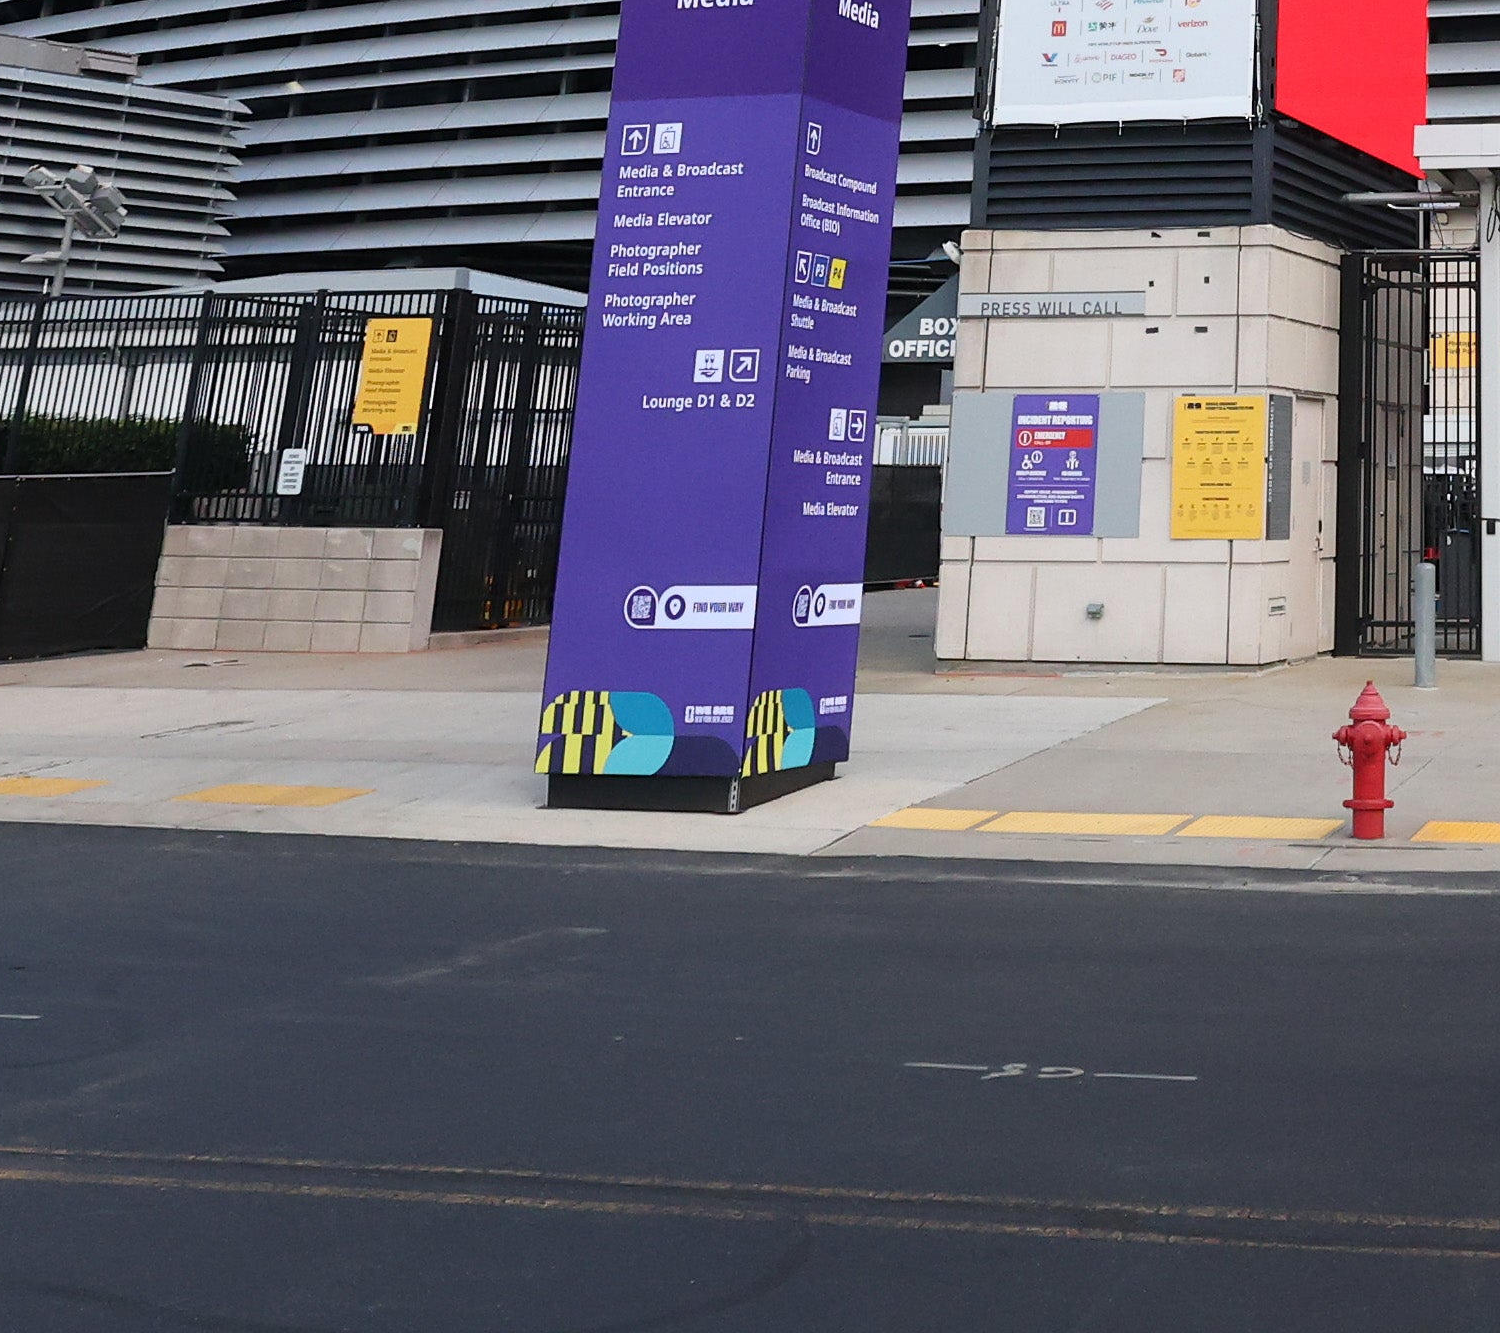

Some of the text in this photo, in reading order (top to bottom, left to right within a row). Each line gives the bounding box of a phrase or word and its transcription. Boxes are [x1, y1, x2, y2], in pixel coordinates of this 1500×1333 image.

[1177, 20, 1208, 28] verizon
[1111, 53, 1137, 61] DIAGEO
[1103, 73, 1117, 82] PIF
[619, 162, 744, 179] Media & Broadcast
[805, 164, 877, 195] Broadcast Compound
[617, 184, 674, 198] Entrance
[802, 194, 879, 224] Broadcast Information
[614, 212, 712, 228] Media Elevator
[800, 214, 840, 236] Office (BIO)
[610, 242, 701, 261] Photographer
[608, 261, 703, 277] Field Positions
[815, 264, 842, 280] P3 P4
[604, 292, 695, 311] Photographer
[793, 293, 857, 317] Media & Broadcast
[980, 300, 1123, 315] PRESS WILL CALL
[603, 311, 691, 329] Working Area
[791, 315, 814, 329] Shuttle
[919, 318, 959, 335] BOX
[788, 345, 852, 366] Media & Broadcast
[786, 364, 811, 383] Parking
[642, 394, 755, 412] Lounge D1 & D2
[1018, 415, 1093, 425] INCIDENT REPORTING
[793, 450, 862, 467] Media & Broadcast
[826, 472, 861, 485] Entrance
[803, 503, 858, 517] Media Elevator
[693, 602, 744, 613] FIND YOUR WAY
